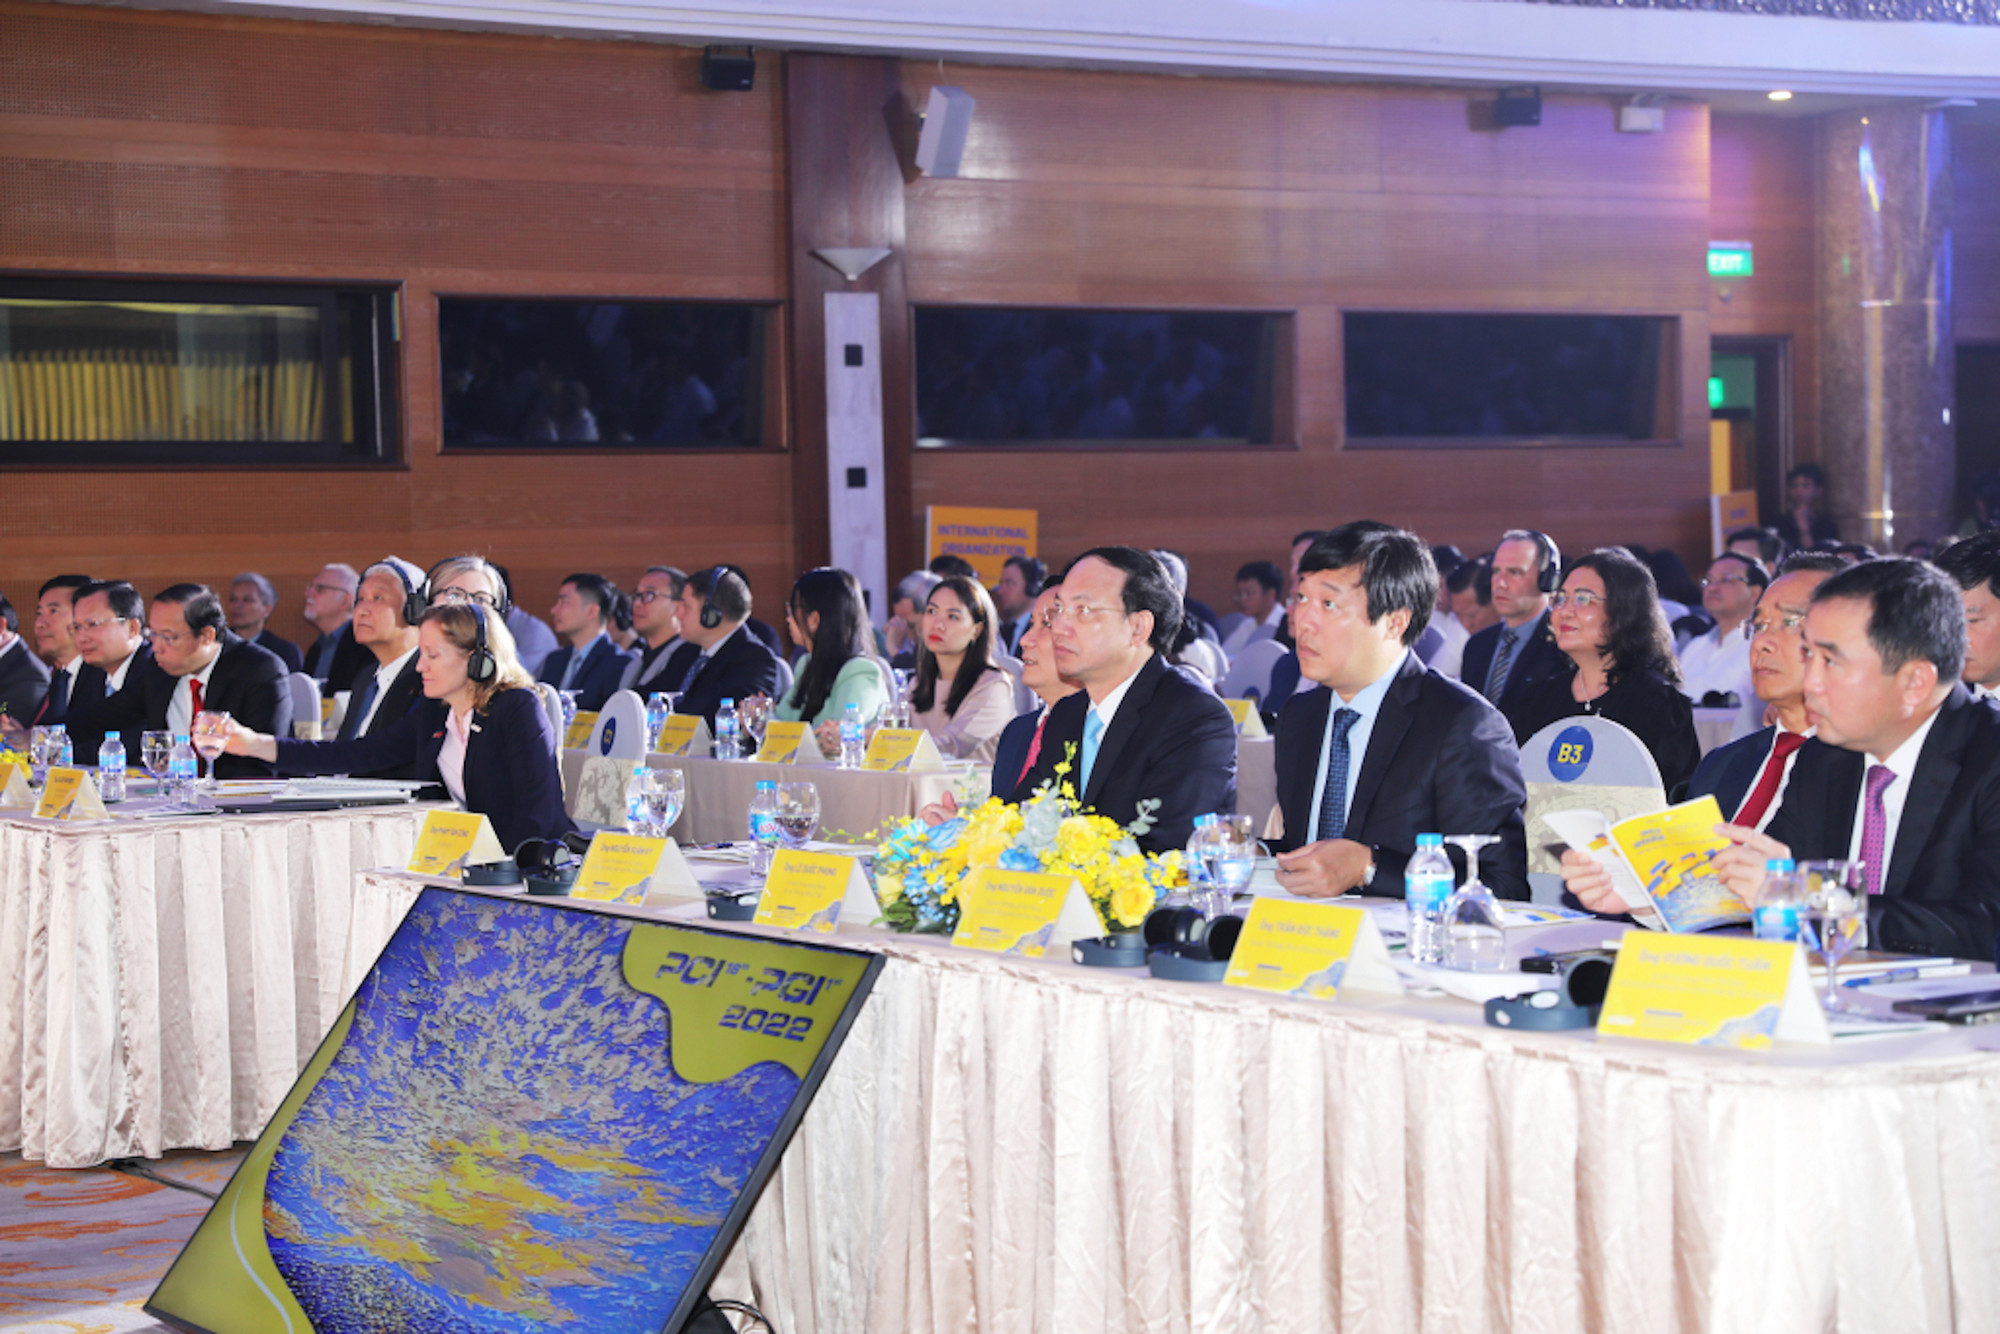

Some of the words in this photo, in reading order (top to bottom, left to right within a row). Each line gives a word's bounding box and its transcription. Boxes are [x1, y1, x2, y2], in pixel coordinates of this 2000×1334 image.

[1709, 253, 1743, 272] EXIT
[937, 525, 1029, 539] INTERNATIONAL
[941, 542, 1026, 557] ORGANIZATION
[1557, 743, 1584, 764] B3
[718, 1004, 814, 1042] 2022
